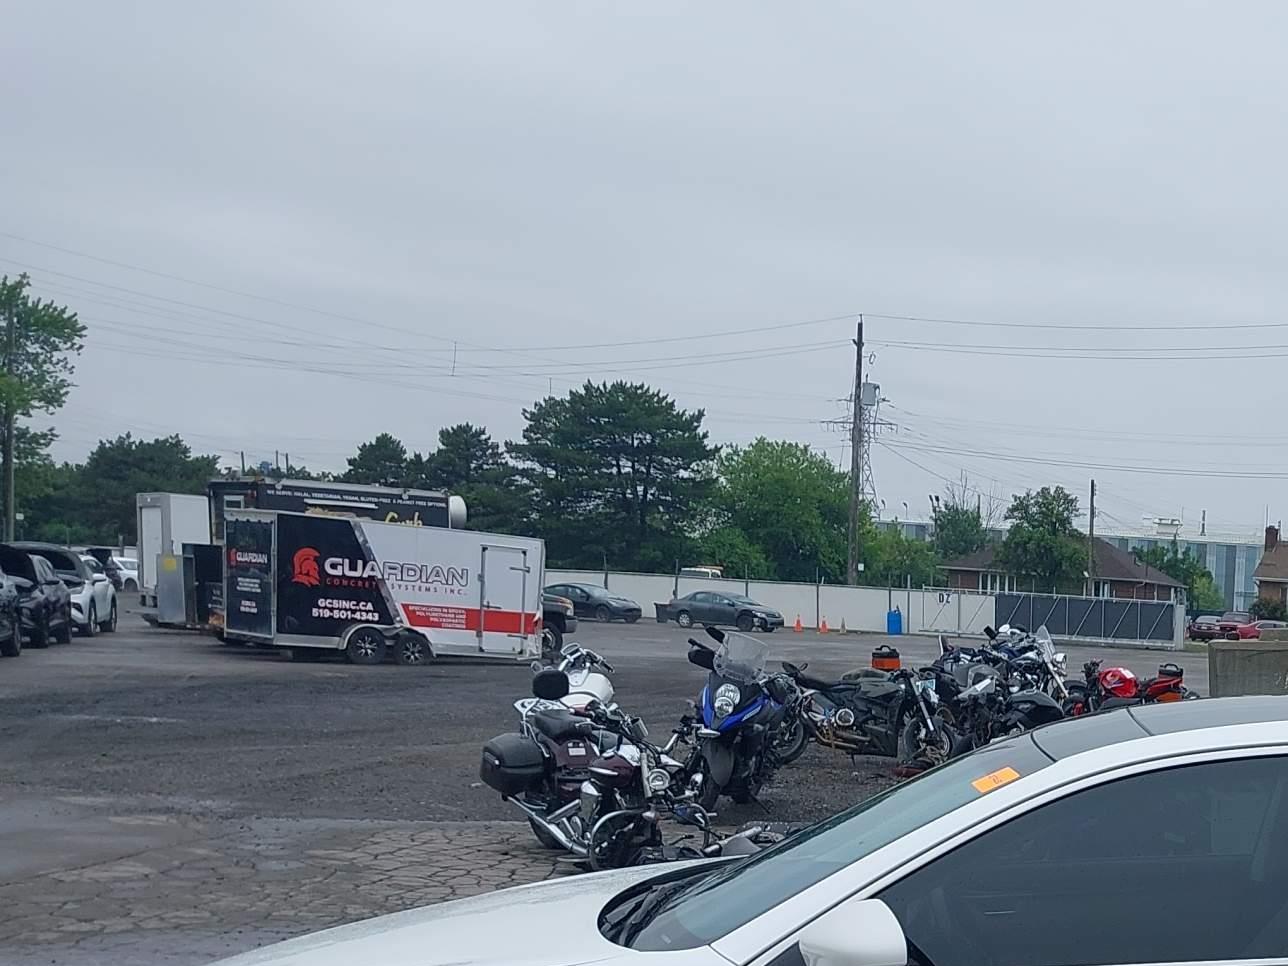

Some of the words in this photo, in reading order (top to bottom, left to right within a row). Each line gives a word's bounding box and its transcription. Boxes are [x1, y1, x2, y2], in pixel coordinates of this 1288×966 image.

[324, 557, 469, 587] GUARDIAN
[326, 577, 378, 589] CONCRET
[391, 583, 438, 593] SYSTEMS
[444, 587, 468, 596] INC.
[317, 598, 374, 611] GCSINC.CA
[311, 607, 380, 621] 519-501-4343
